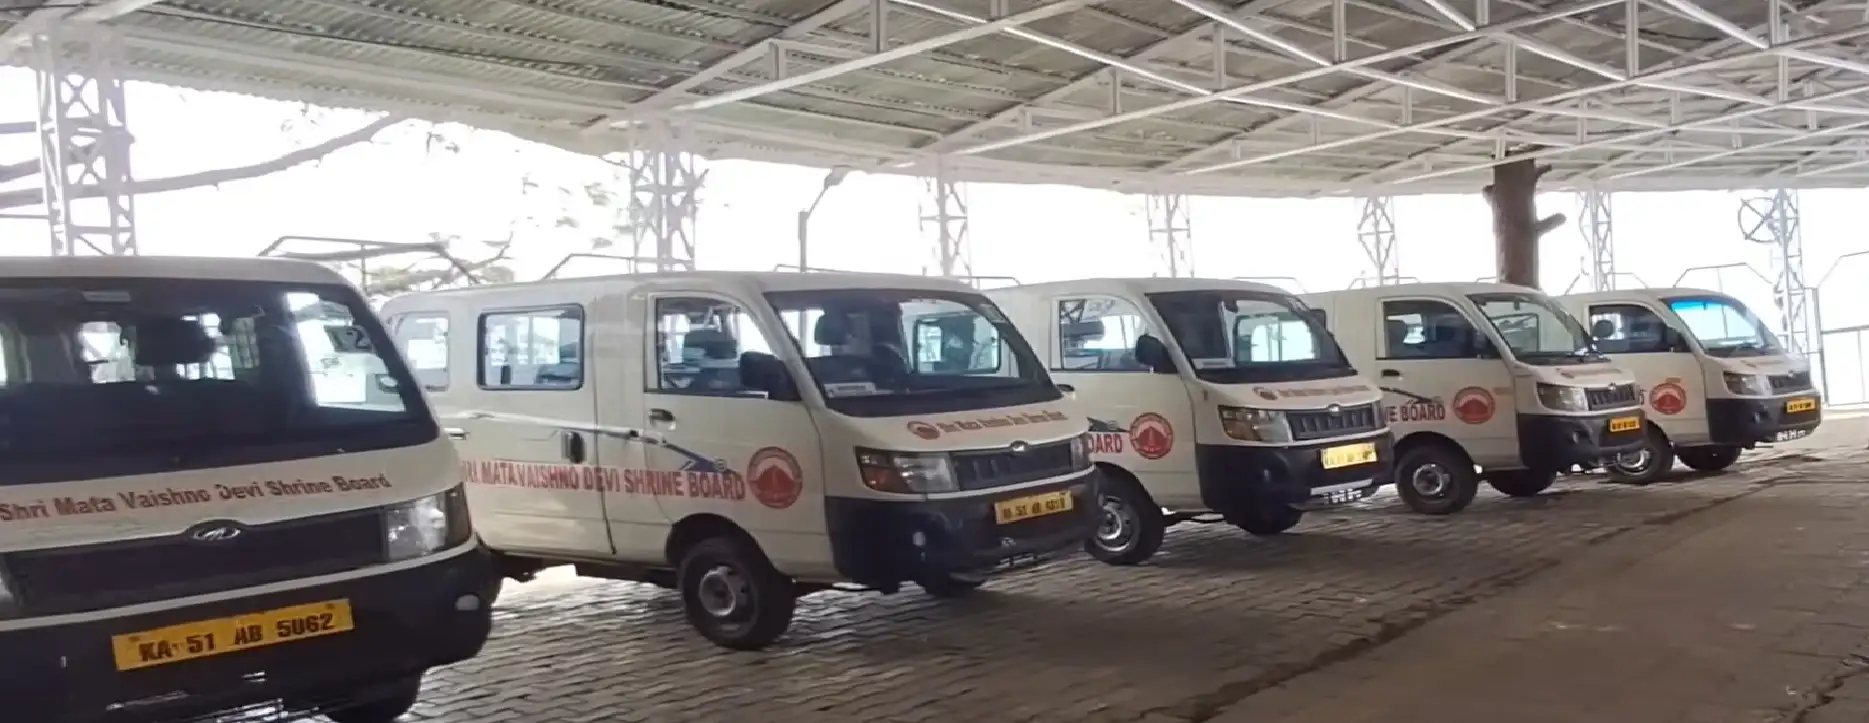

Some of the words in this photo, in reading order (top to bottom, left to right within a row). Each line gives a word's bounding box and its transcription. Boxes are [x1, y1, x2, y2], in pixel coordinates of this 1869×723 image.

[1401, 403, 1446, 421] BOARD
[1086, 432, 1123, 453] OARD
[0, 499, 51, 521] Shri
[53, 496, 117, 516] Mata
[117, 487, 211, 509] Vaishno
[214, 481, 265, 500] Devi
[265, 478, 333, 496] Shrine
[332, 473, 392, 492] Board
[583, 465, 620, 493] DEVI
[624, 468, 685, 497] SHRINE
[689, 471, 745, 500] BOARD
[138, 640, 172, 662] KA
[186, 633, 215, 654] 51
[234, 625, 263, 645] AB
[276, 612, 335, 637] 5062
